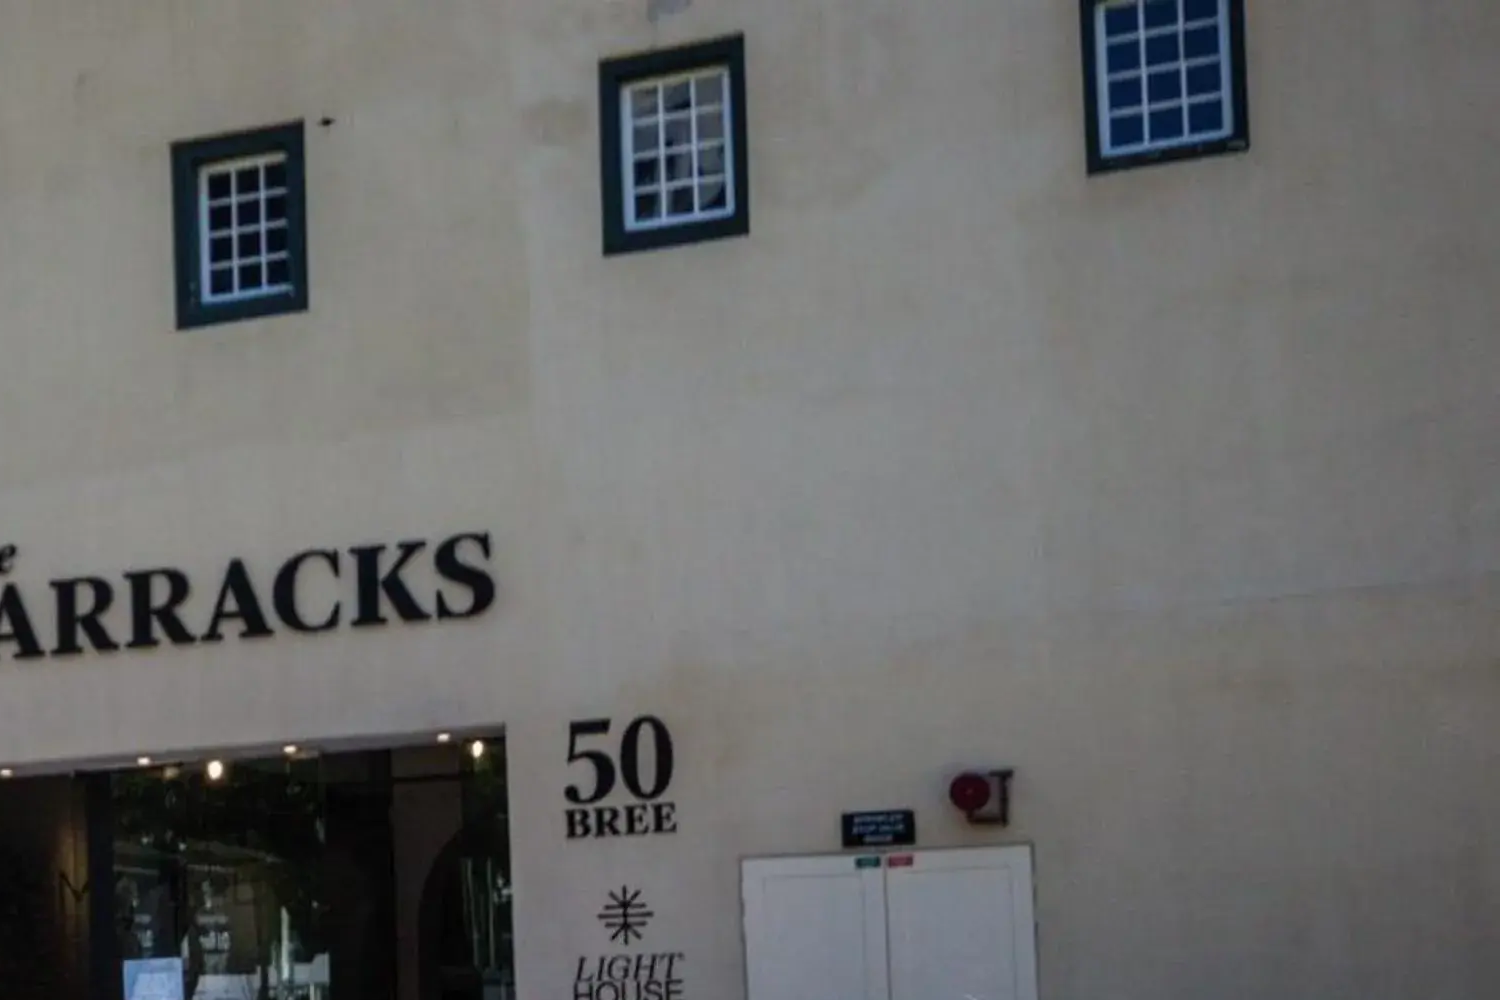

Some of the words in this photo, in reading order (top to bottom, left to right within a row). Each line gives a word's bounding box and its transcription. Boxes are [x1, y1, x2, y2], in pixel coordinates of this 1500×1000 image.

[564, 715, 674, 805] 50
[564, 803, 678, 839] BREE
[575, 953, 686, 982] LIGHT
